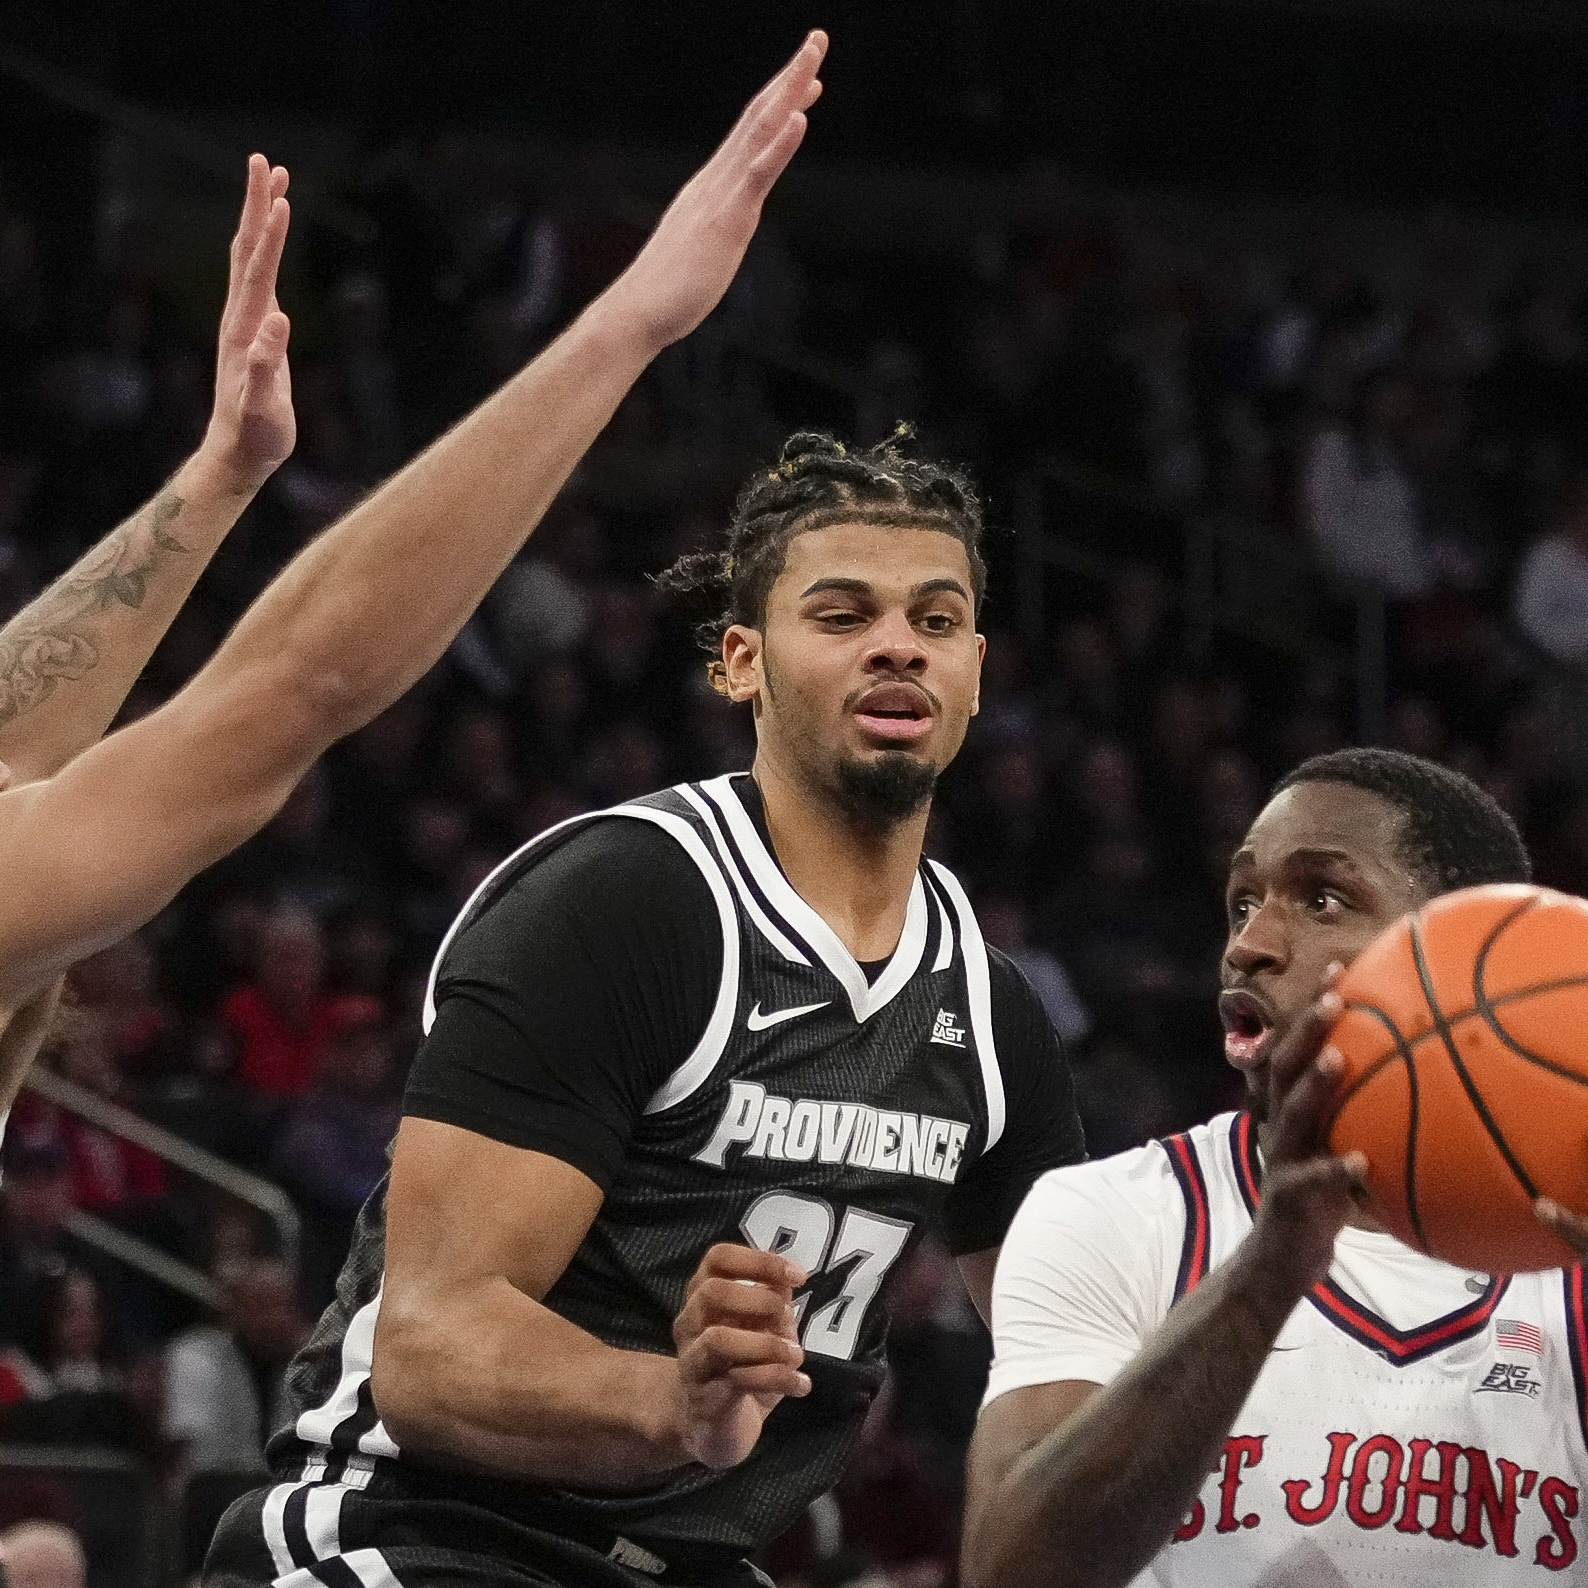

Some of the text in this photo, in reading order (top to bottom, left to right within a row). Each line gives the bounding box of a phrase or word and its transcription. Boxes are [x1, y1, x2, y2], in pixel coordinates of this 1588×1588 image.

[932, 1022, 966, 1042] EAST
[690, 1079, 971, 1184] PROVIDENCE
[1489, 1362, 1532, 1379] BIG
[1481, 1375, 1542, 1395] EAST
[1280, 1431, 1580, 1571] JOHN'S
